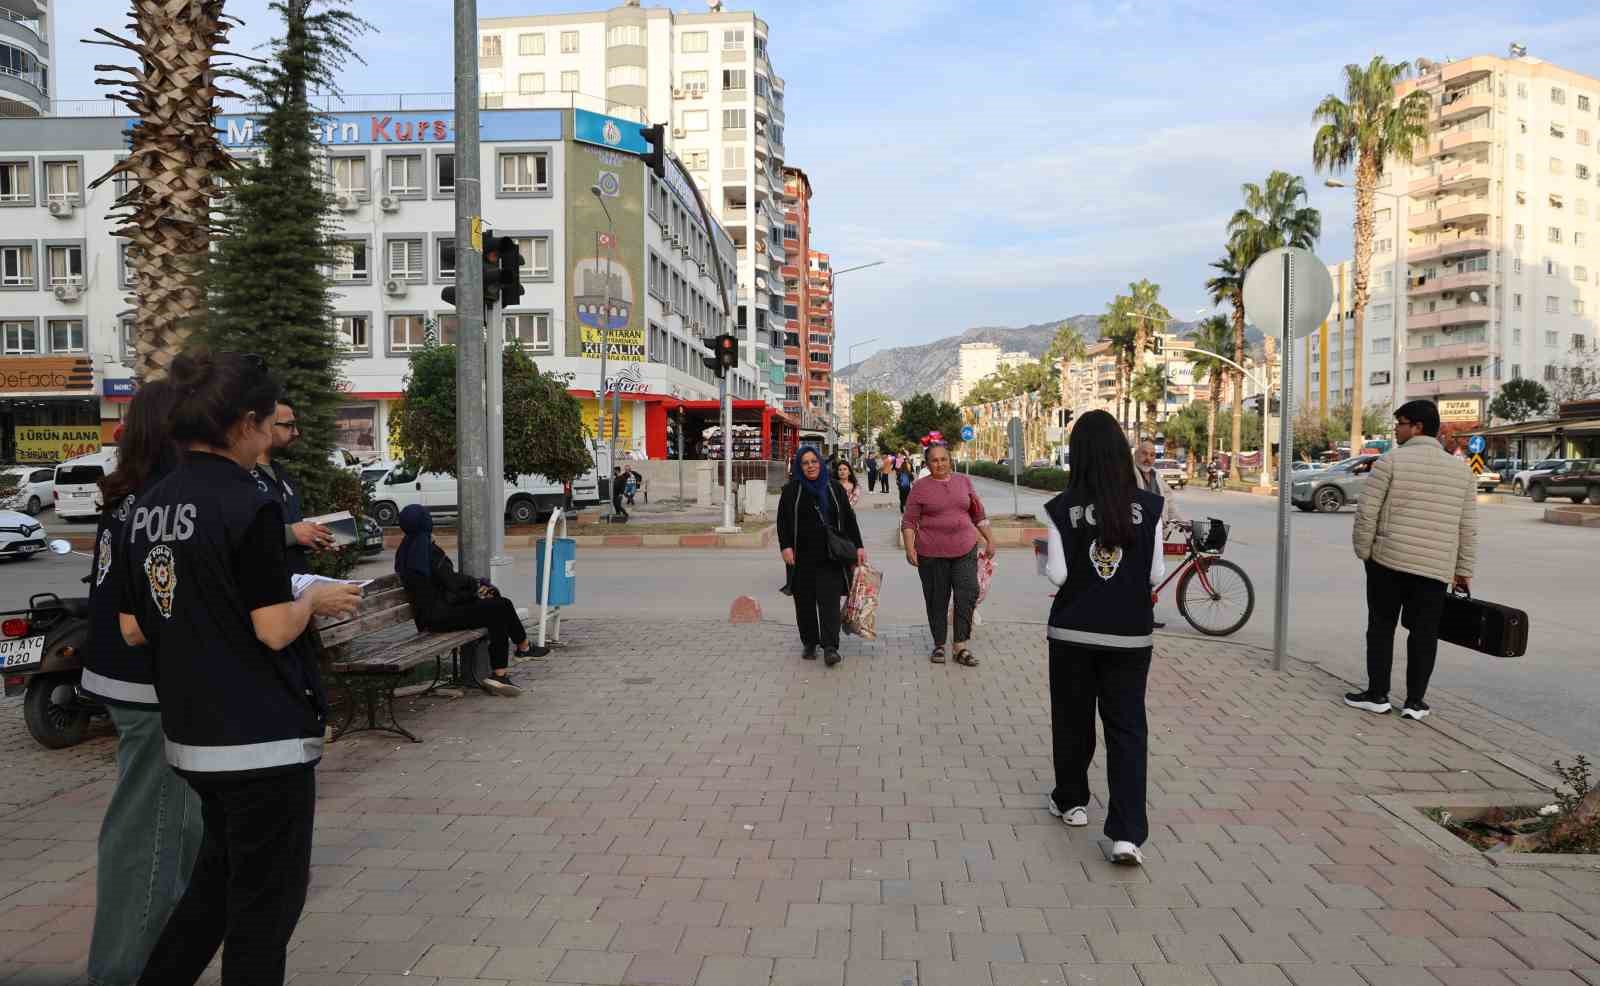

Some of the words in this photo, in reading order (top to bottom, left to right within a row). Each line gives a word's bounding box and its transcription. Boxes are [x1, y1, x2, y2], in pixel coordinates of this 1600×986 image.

[585, 342, 641, 355] KIALIK
[62, 431, 99, 441] ALANA
[1069, 502, 1143, 528] POS
[130, 503, 197, 543] POLIS
[19, 637, 43, 650] AYC
[7, 652, 30, 665] 820
